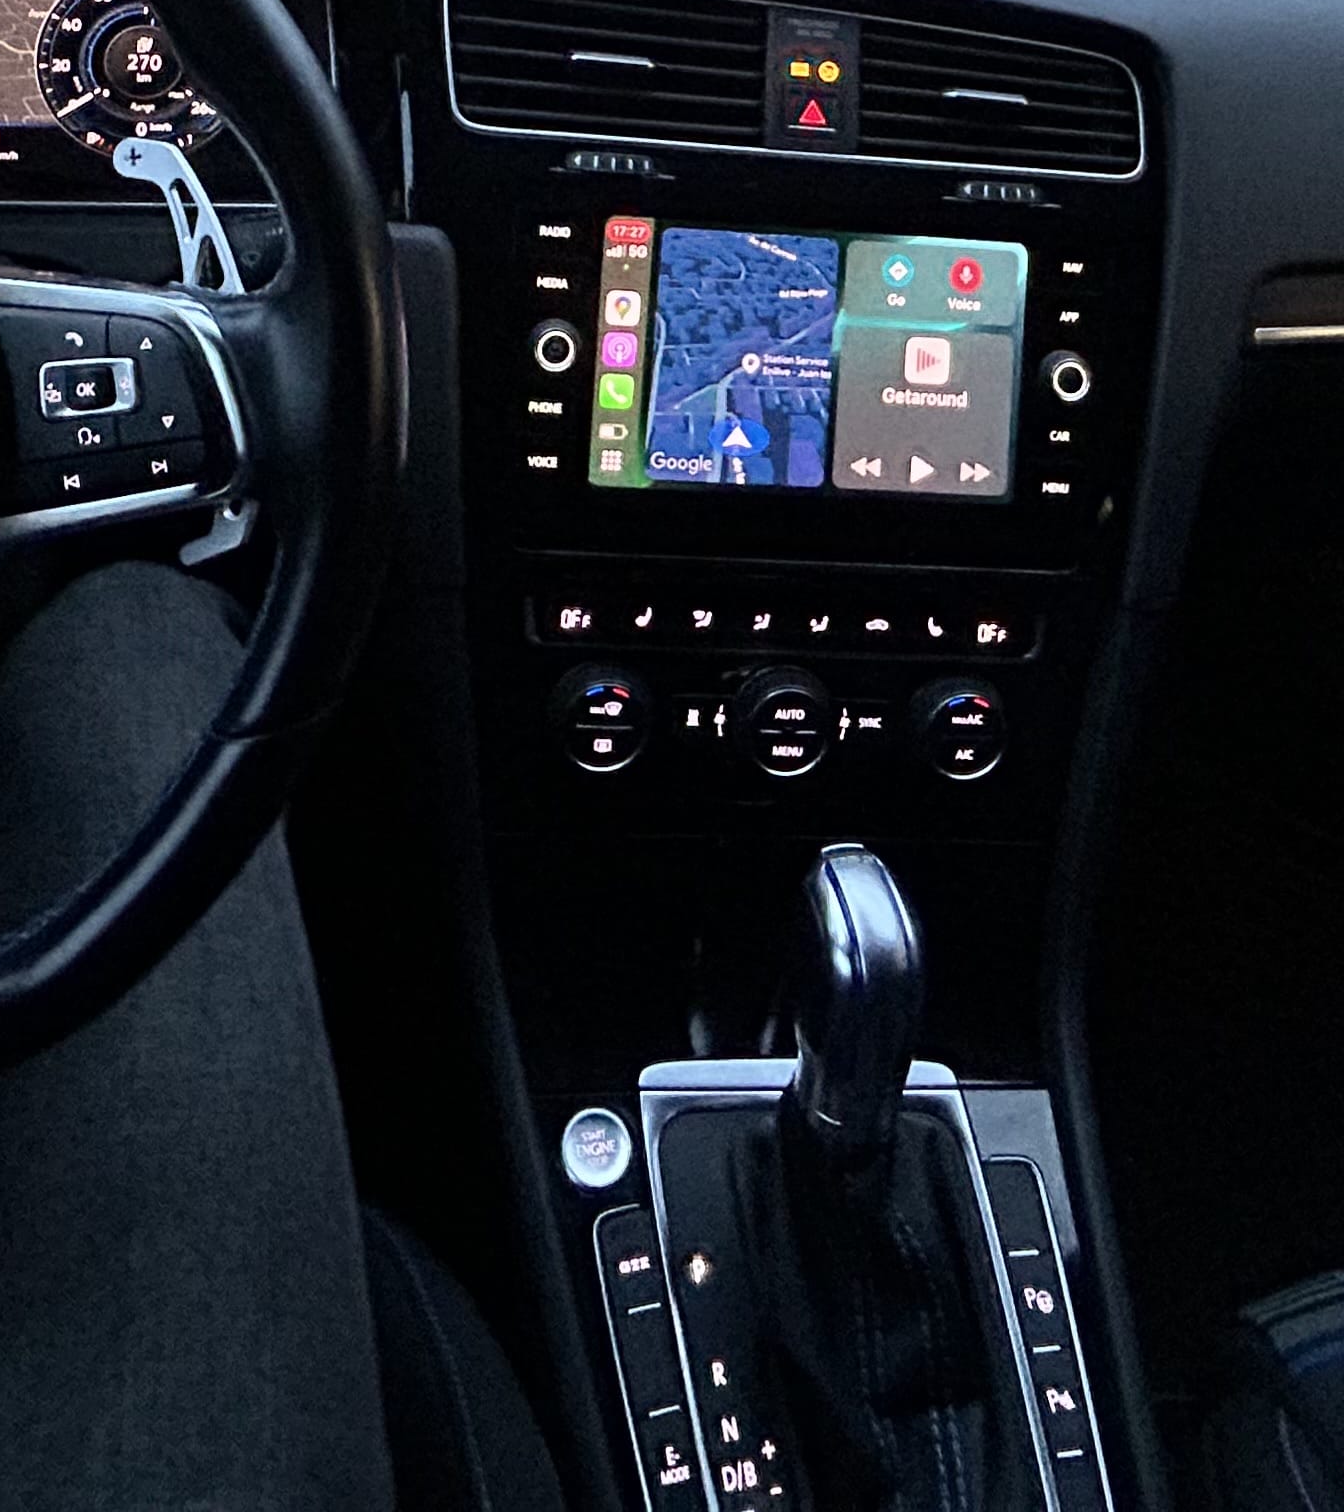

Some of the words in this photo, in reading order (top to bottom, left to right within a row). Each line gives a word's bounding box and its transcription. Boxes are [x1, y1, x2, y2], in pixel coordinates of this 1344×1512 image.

[61, 18, 83, 32] 40
[51, 59, 71, 73] 20
[126, 54, 163, 71] 270
[135, 121, 148, 137] 0
[538, 225, 571, 238] RADIO
[612, 225, 647, 238] 17:27
[1063, 262, 1084, 274] NAV
[536, 276, 569, 289] MEDIA
[887, 293, 905, 307] Go
[948, 297, 981, 311] Voice
[1059, 311, 1080, 323] APP
[76, 382, 96, 397] OK
[882, 387, 968, 408] Getaround
[528, 400, 563, 414] PHONE
[1049, 430, 1070, 442] CAR
[527, 455, 558, 469] VOICE
[650, 452, 713, 475] Google
[1042, 482, 1070, 494] MENU
[775, 708, 806, 720] AUTO
[772, 746, 804, 757] MENU
[955, 749, 974, 761] A/C
[576, 1139, 616, 1158] ENGINE
[690, 1256, 706, 1284] P
[711, 1361, 727, 1387] R
[721, 1416, 739, 1443] N
[660, 1465, 690, 1486] MODE
[721, 1460, 758, 1493] D/B
